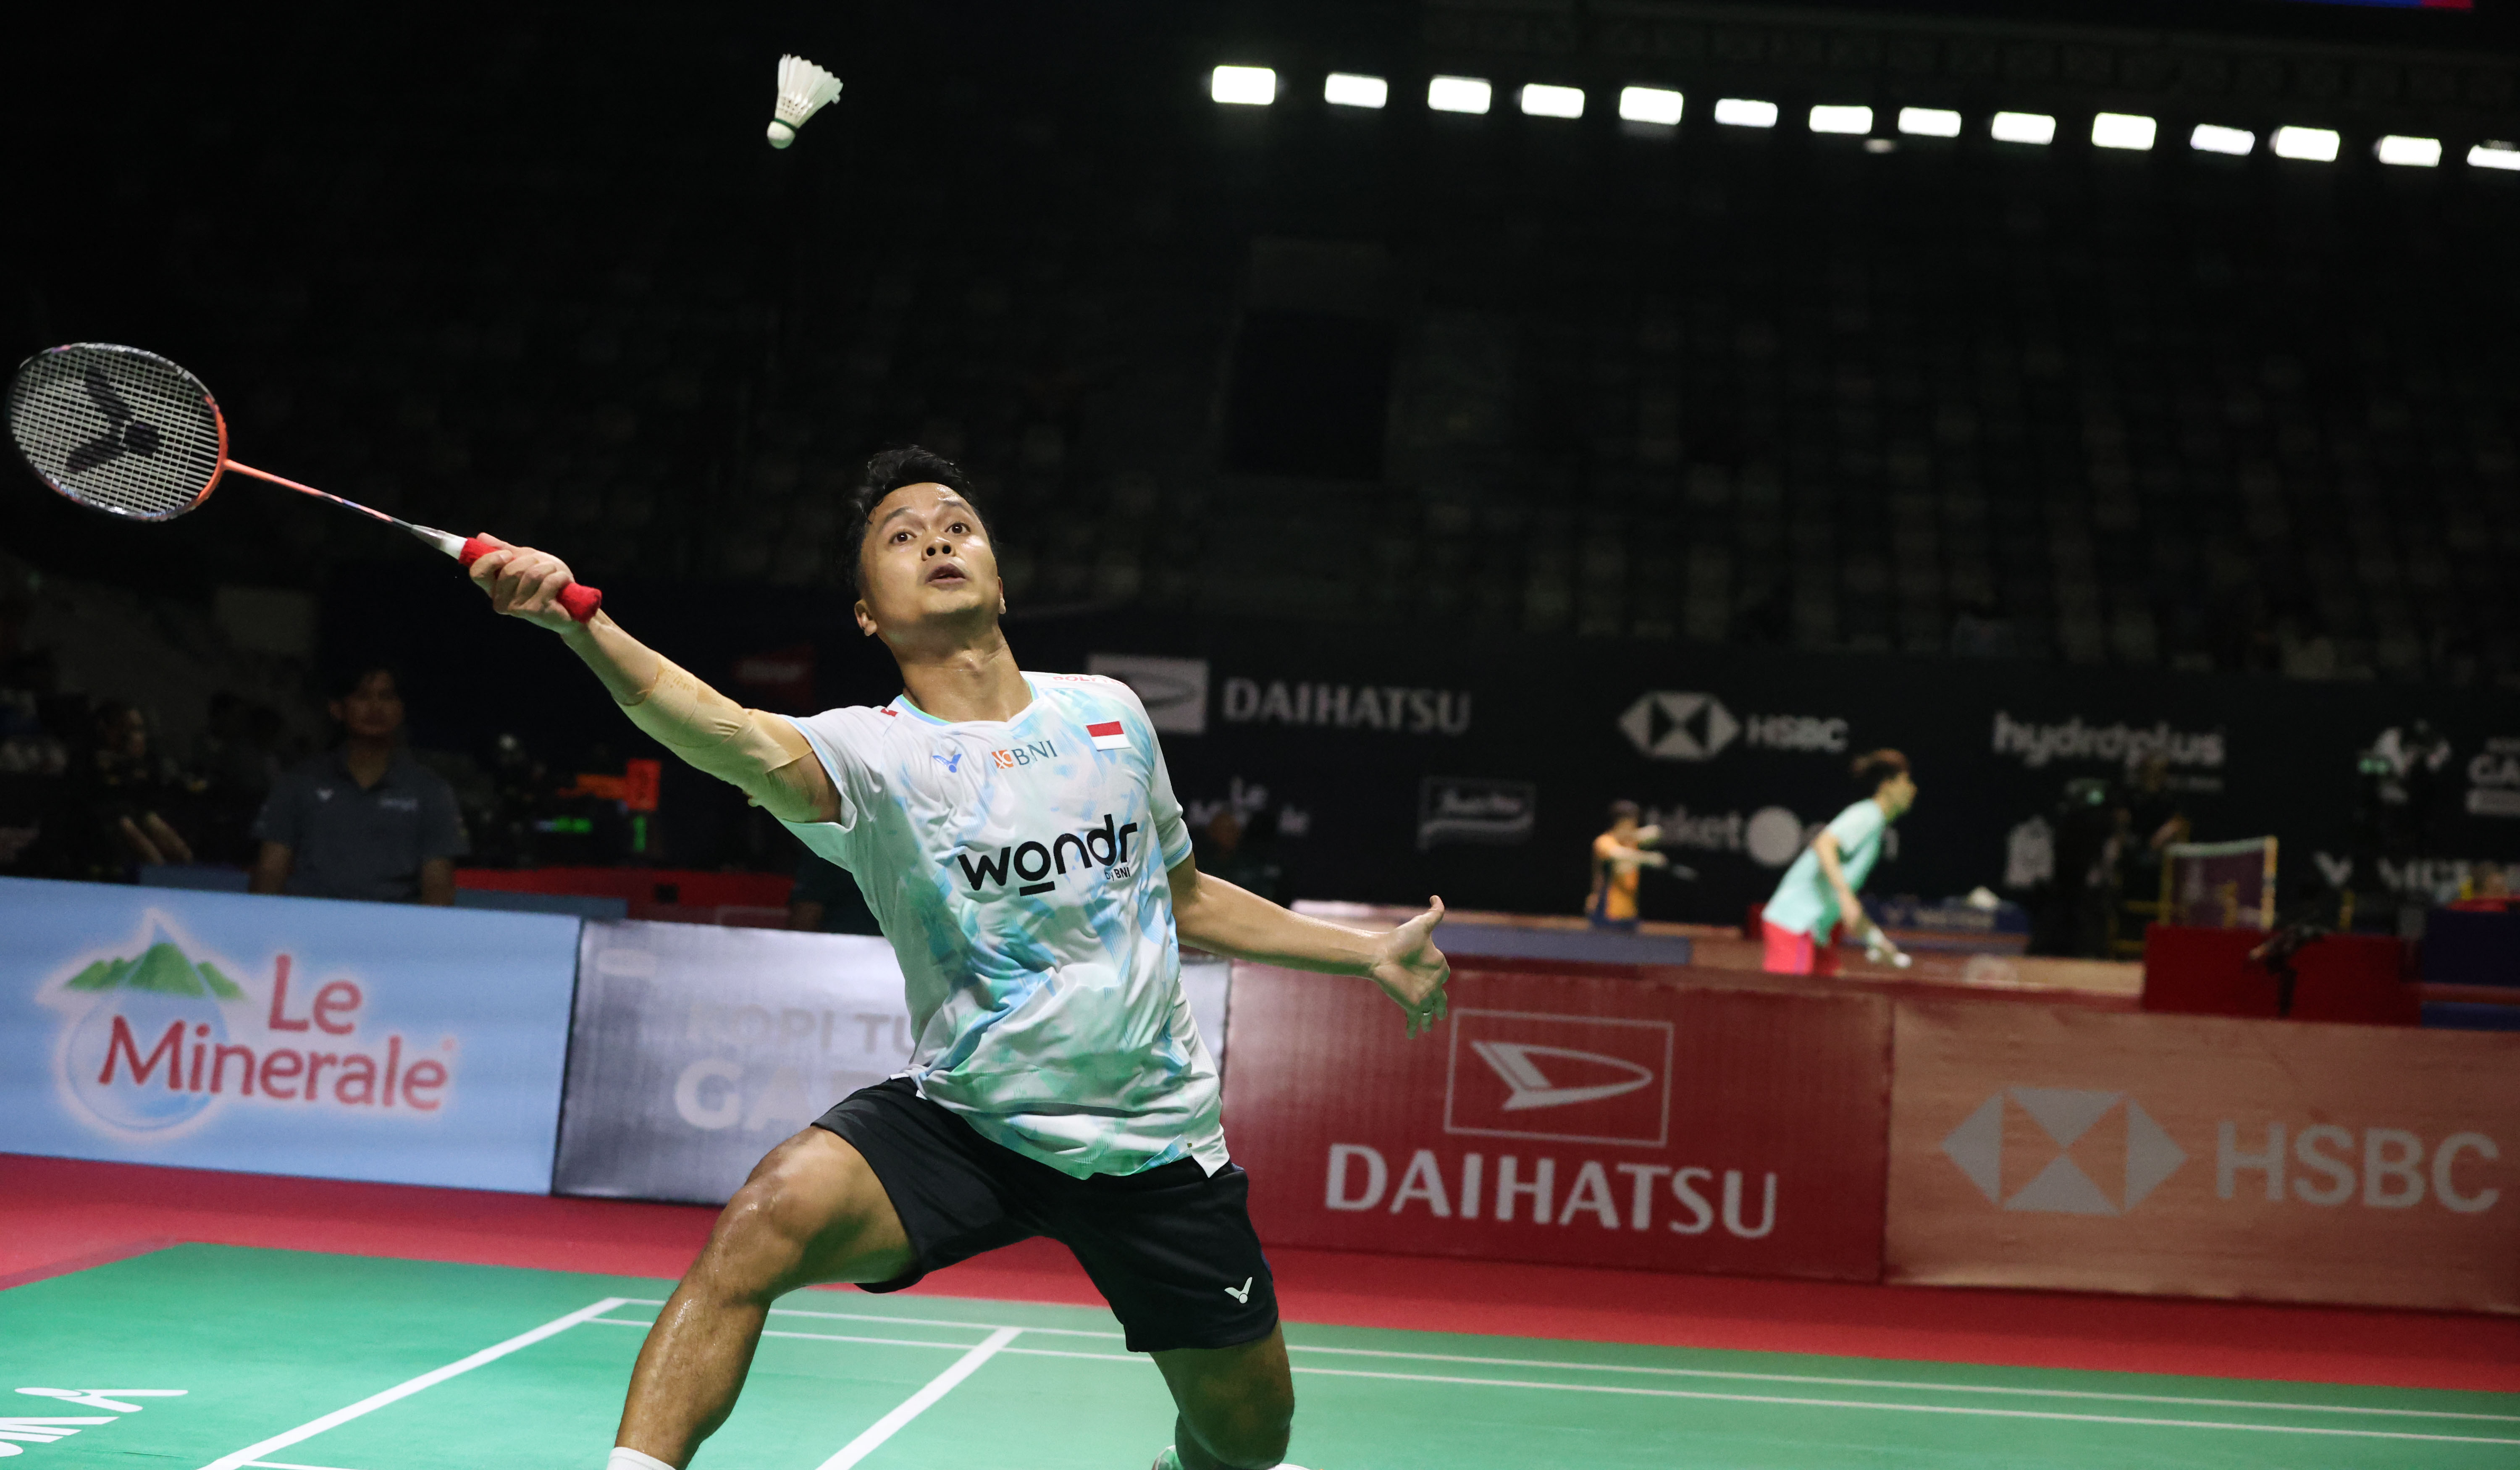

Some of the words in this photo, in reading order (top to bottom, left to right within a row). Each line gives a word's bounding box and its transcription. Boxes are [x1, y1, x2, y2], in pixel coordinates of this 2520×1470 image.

[1222, 677, 1472, 736] DAIHATSU
[1744, 713, 1850, 754] HSBC
[1992, 709, 2226, 768] hydroplus
[1011, 740, 1058, 765] BNI
[958, 814, 1137, 895] wondr
[1104, 869, 1114, 881] by
[1114, 867, 1130, 878] BNI
[268, 955, 362, 1036] Le
[100, 1016, 448, 1111] Minerale
[1324, 1143, 1777, 1239] DAIHATSU
[2216, 1120, 2500, 1213] HSBC
